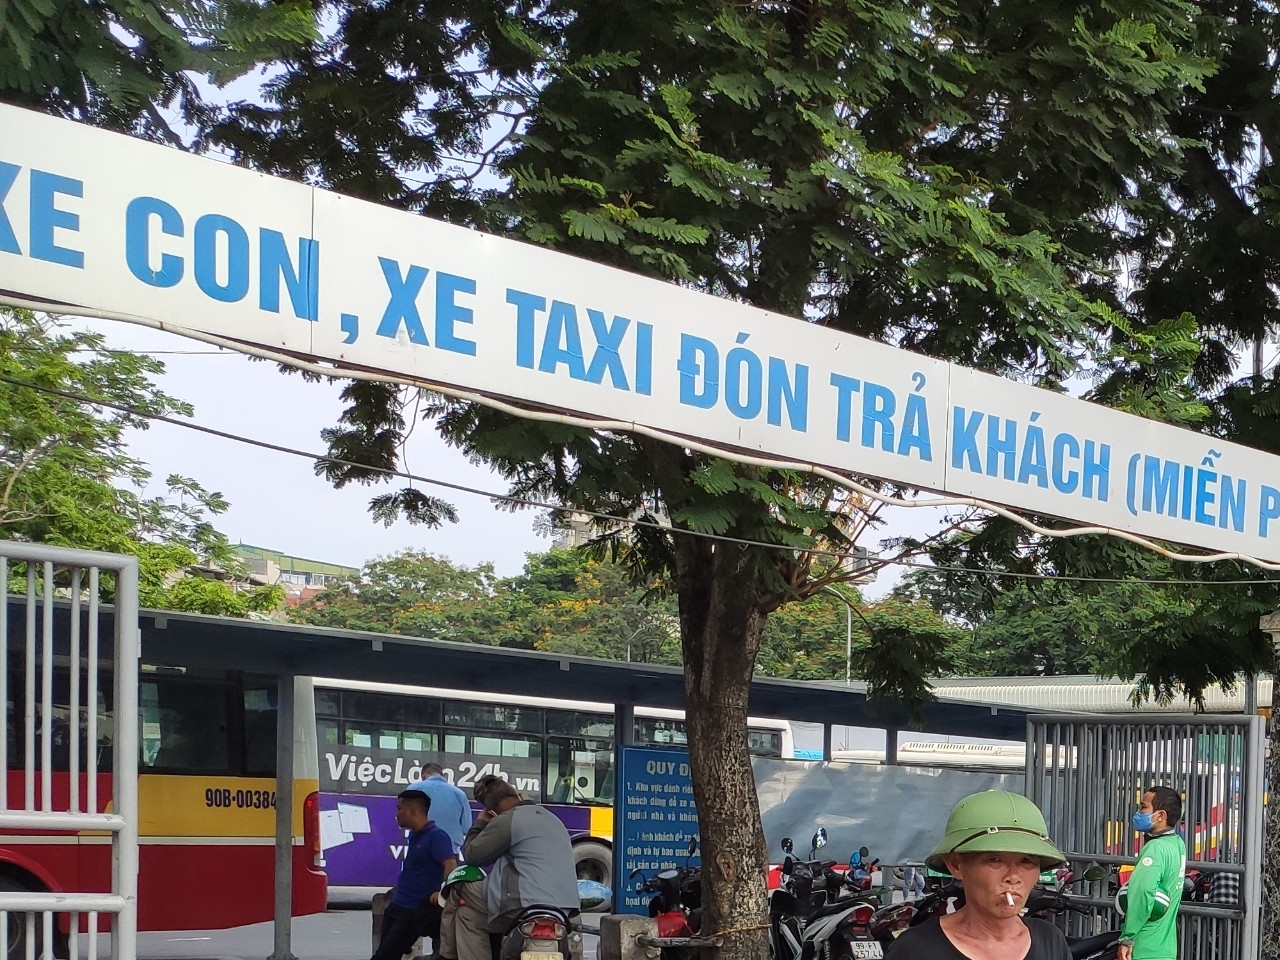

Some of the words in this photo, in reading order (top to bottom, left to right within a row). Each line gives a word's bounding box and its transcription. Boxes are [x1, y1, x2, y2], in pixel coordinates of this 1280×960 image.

[505, 288, 654, 396] TAXI
[676, 331, 809, 433] ĐÓN
[829, 371, 933, 463] TRẢ
[951, 406, 1111, 502] KHÁCH
[1126, 448, 1247, 533] (MIỄN
[646, 760, 676, 775] QUY
